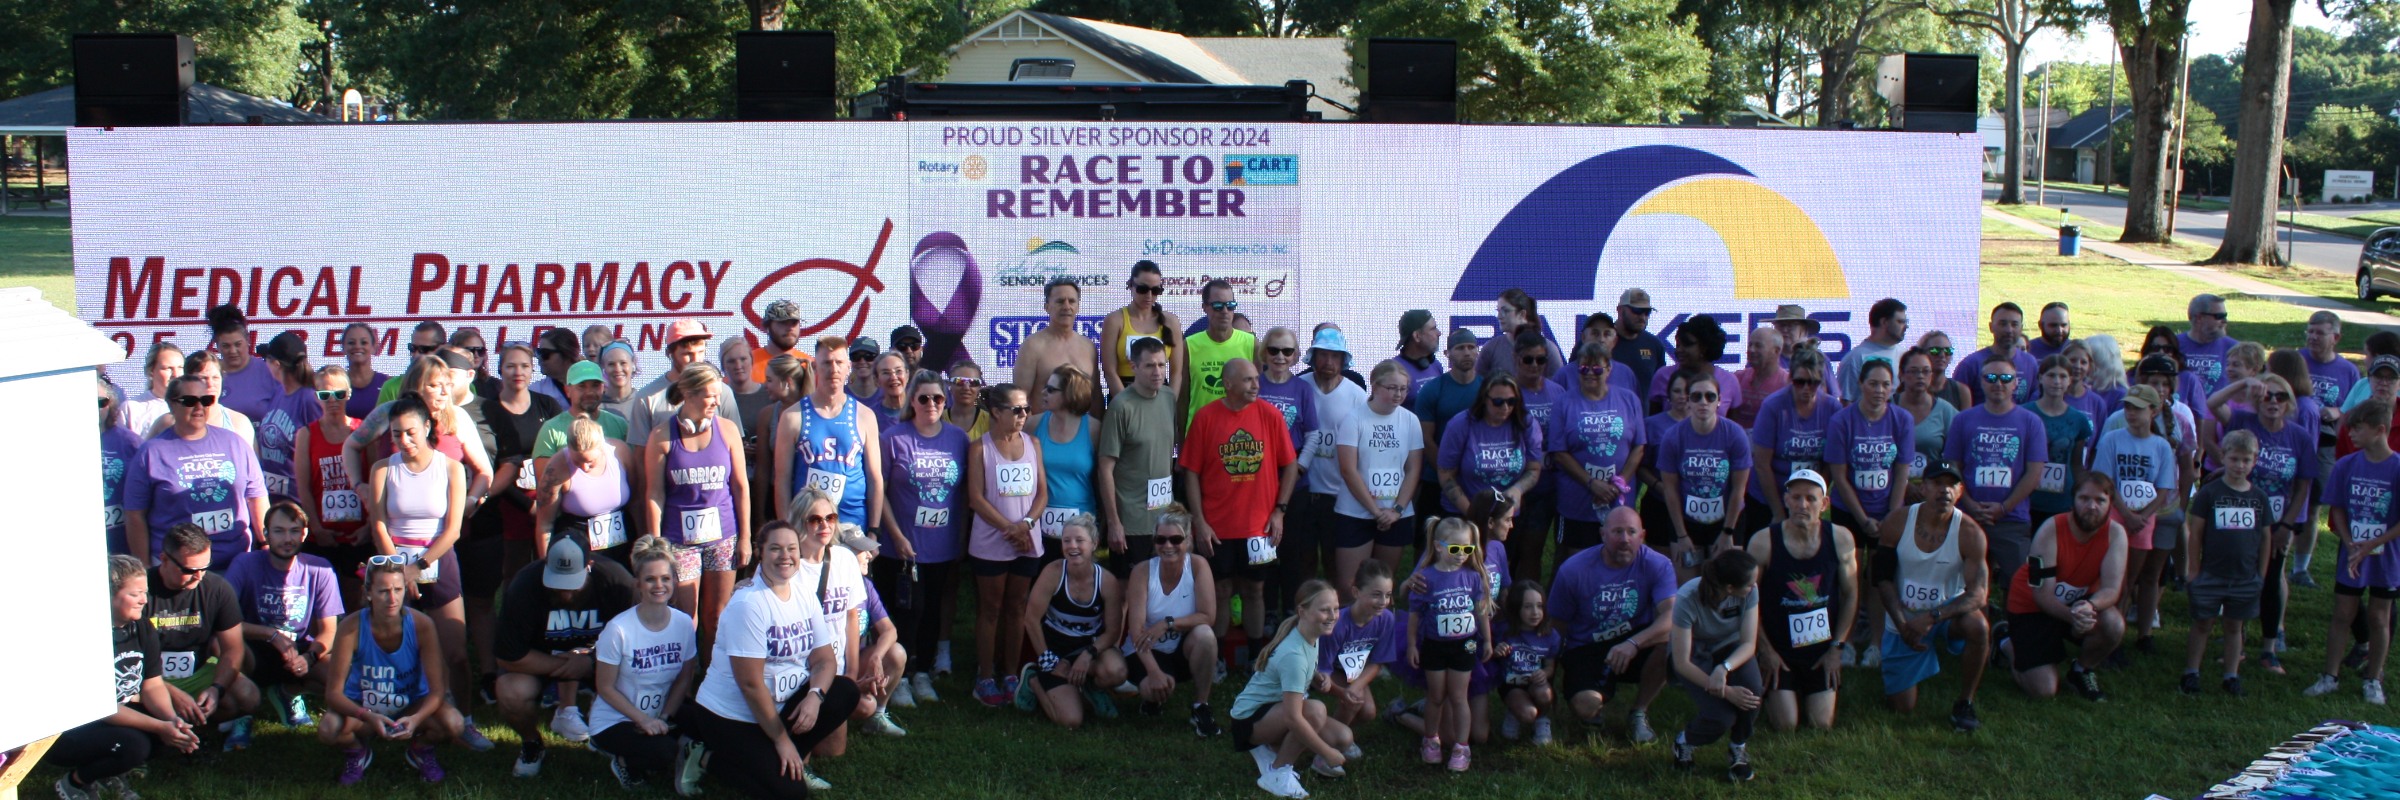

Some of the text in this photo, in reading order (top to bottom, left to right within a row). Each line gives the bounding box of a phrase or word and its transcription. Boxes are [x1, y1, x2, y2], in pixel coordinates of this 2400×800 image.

[943, 127, 1270, 147] PROUD SILVER SPONSOR 2024
[918, 160, 958, 174] Rotary
[1020, 154, 1214, 184] RACE TO
[1248, 157, 1291, 171] CART
[986, 189, 1246, 218] REMEMBER
[104, 252, 733, 319] MEDICAL PHARMACY
[1000, 275, 1046, 286] SENIOR
[1160, 276, 1197, 286] EDICAL
[2187, 359, 2215, 368] RACE
[2313, 381, 2333, 390] ACE
[1584, 415, 1615, 425] RACE
[1373, 424, 1394, 432] YOUR
[1373, 432, 1395, 440] ROYAL
[1791, 437, 1822, 448] RACE
[1980, 432, 2013, 444] RACE
[1369, 440, 1400, 448] FLYNESS
[1858, 442, 1892, 454] RACE
[1482, 448, 1514, 459] RACE
[2117, 454, 2152, 467] RISE
[183, 460, 224, 472] RACE
[917, 458, 950, 469] RACE
[1688, 456, 1721, 468] RACE
[671, 465, 726, 486] WARRIOR
[1000, 467, 1032, 483] 023
[1979, 470, 2009, 486] 117
[2119, 466, 2146, 478] AND
[810, 473, 842, 493] 039
[1372, 472, 1400, 487] 029
[1859, 473, 1886, 488] 116
[2123, 484, 2154, 498] 069
[2351, 484, 2387, 498] RACE
[326, 494, 358, 509] 033
[1689, 500, 1720, 514] 007
[196, 512, 231, 532] 113
[919, 509, 948, 526] 142
[2219, 511, 2253, 527] 146
[592, 516, 622, 537] 075
[264, 593, 301, 605] RACE
[1906, 584, 1939, 600] 058
[1438, 595, 1472, 609] RACE
[547, 609, 604, 630] MVL
[1441, 616, 1472, 634] 137
[1793, 613, 1826, 633] 078
[766, 617, 813, 640] MEMORIE
[633, 642, 682, 658] MEMORIES
[767, 633, 814, 657] MATTE
[631, 652, 682, 669] MATTER
[1514, 651, 1544, 662] RACE
[363, 665, 395, 679] run
[368, 693, 404, 708] 040
